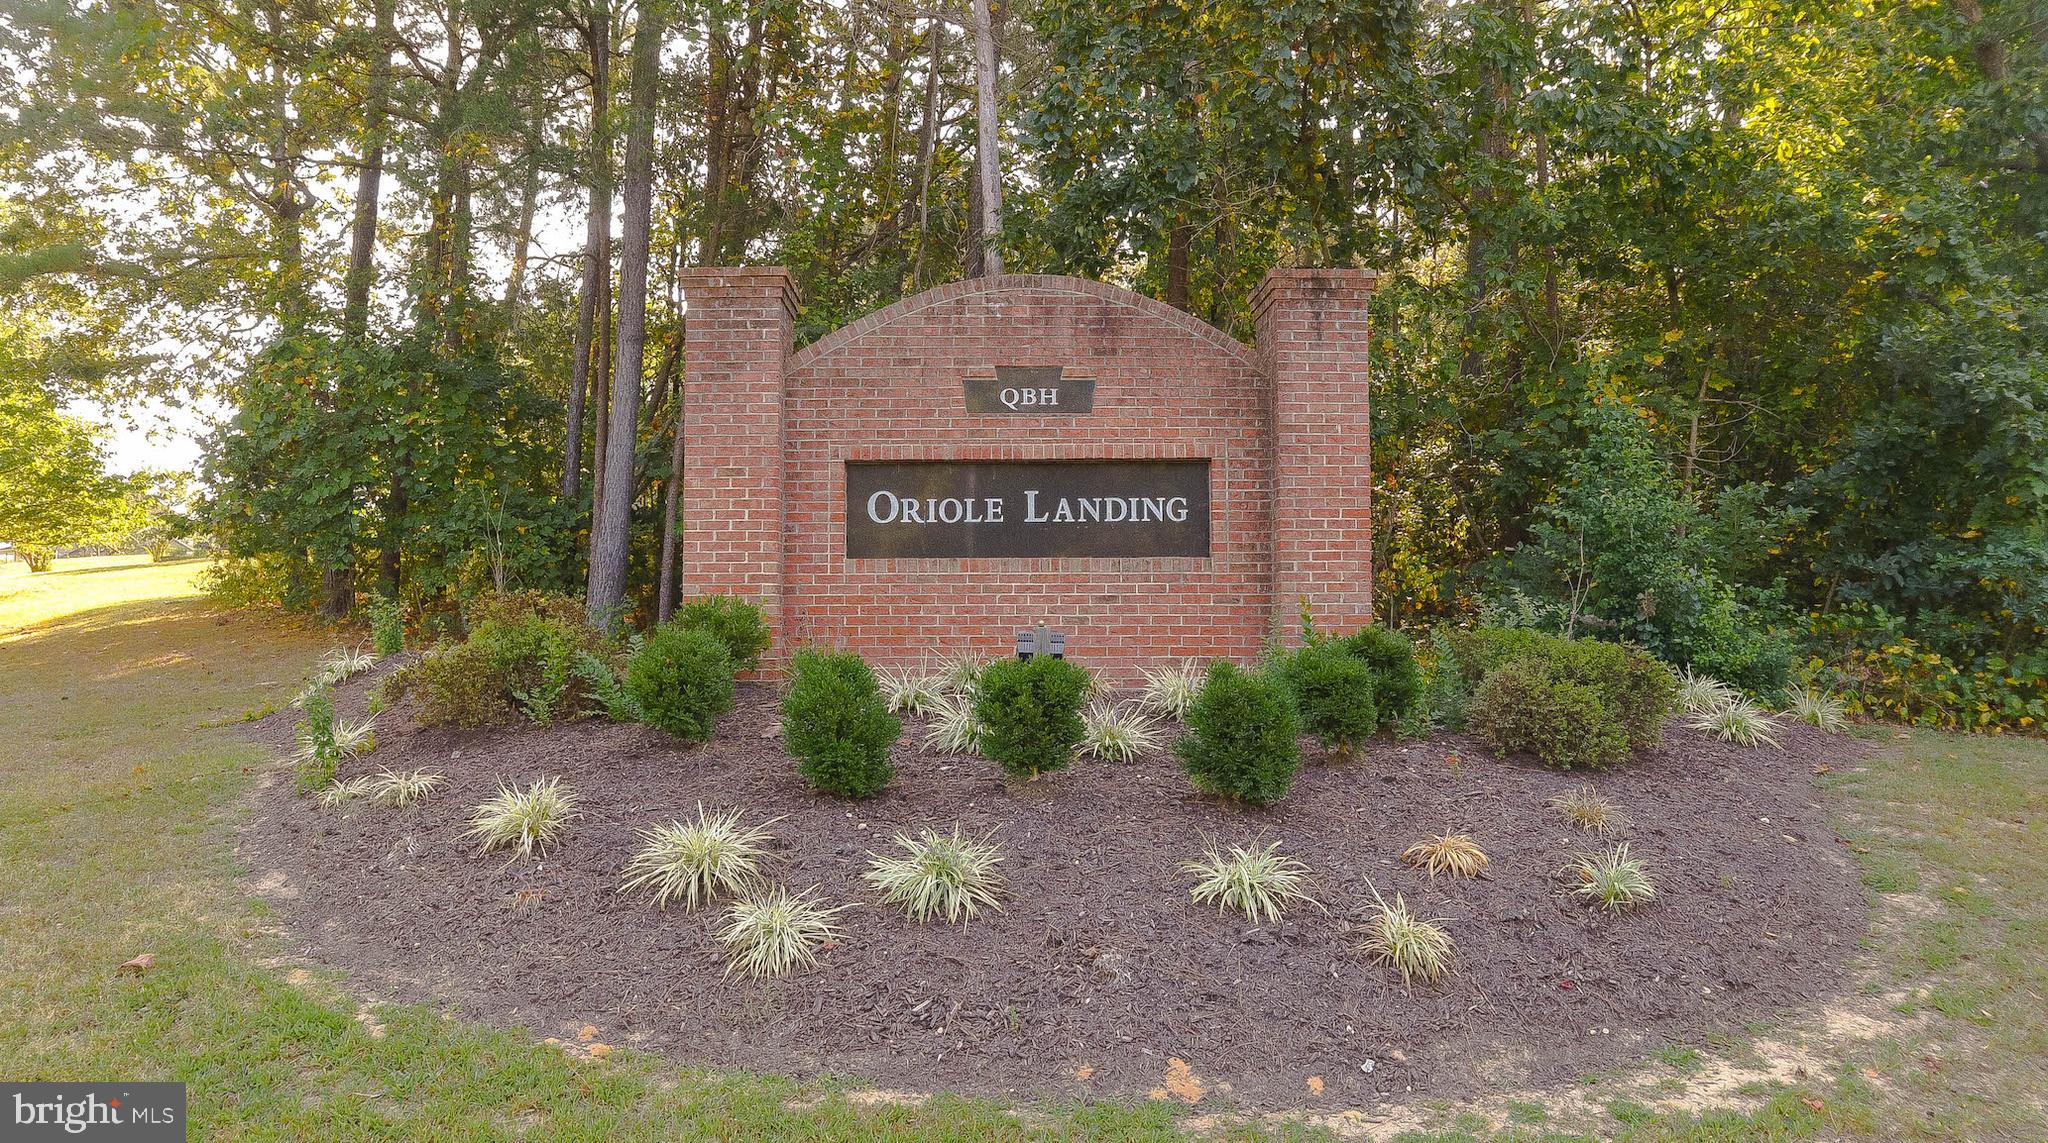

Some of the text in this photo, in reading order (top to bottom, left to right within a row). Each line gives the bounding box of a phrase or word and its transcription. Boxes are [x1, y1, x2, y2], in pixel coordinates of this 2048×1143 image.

[999, 387, 1059, 411] QBH
[866, 490, 1190, 525] ORIOLE LANDING
